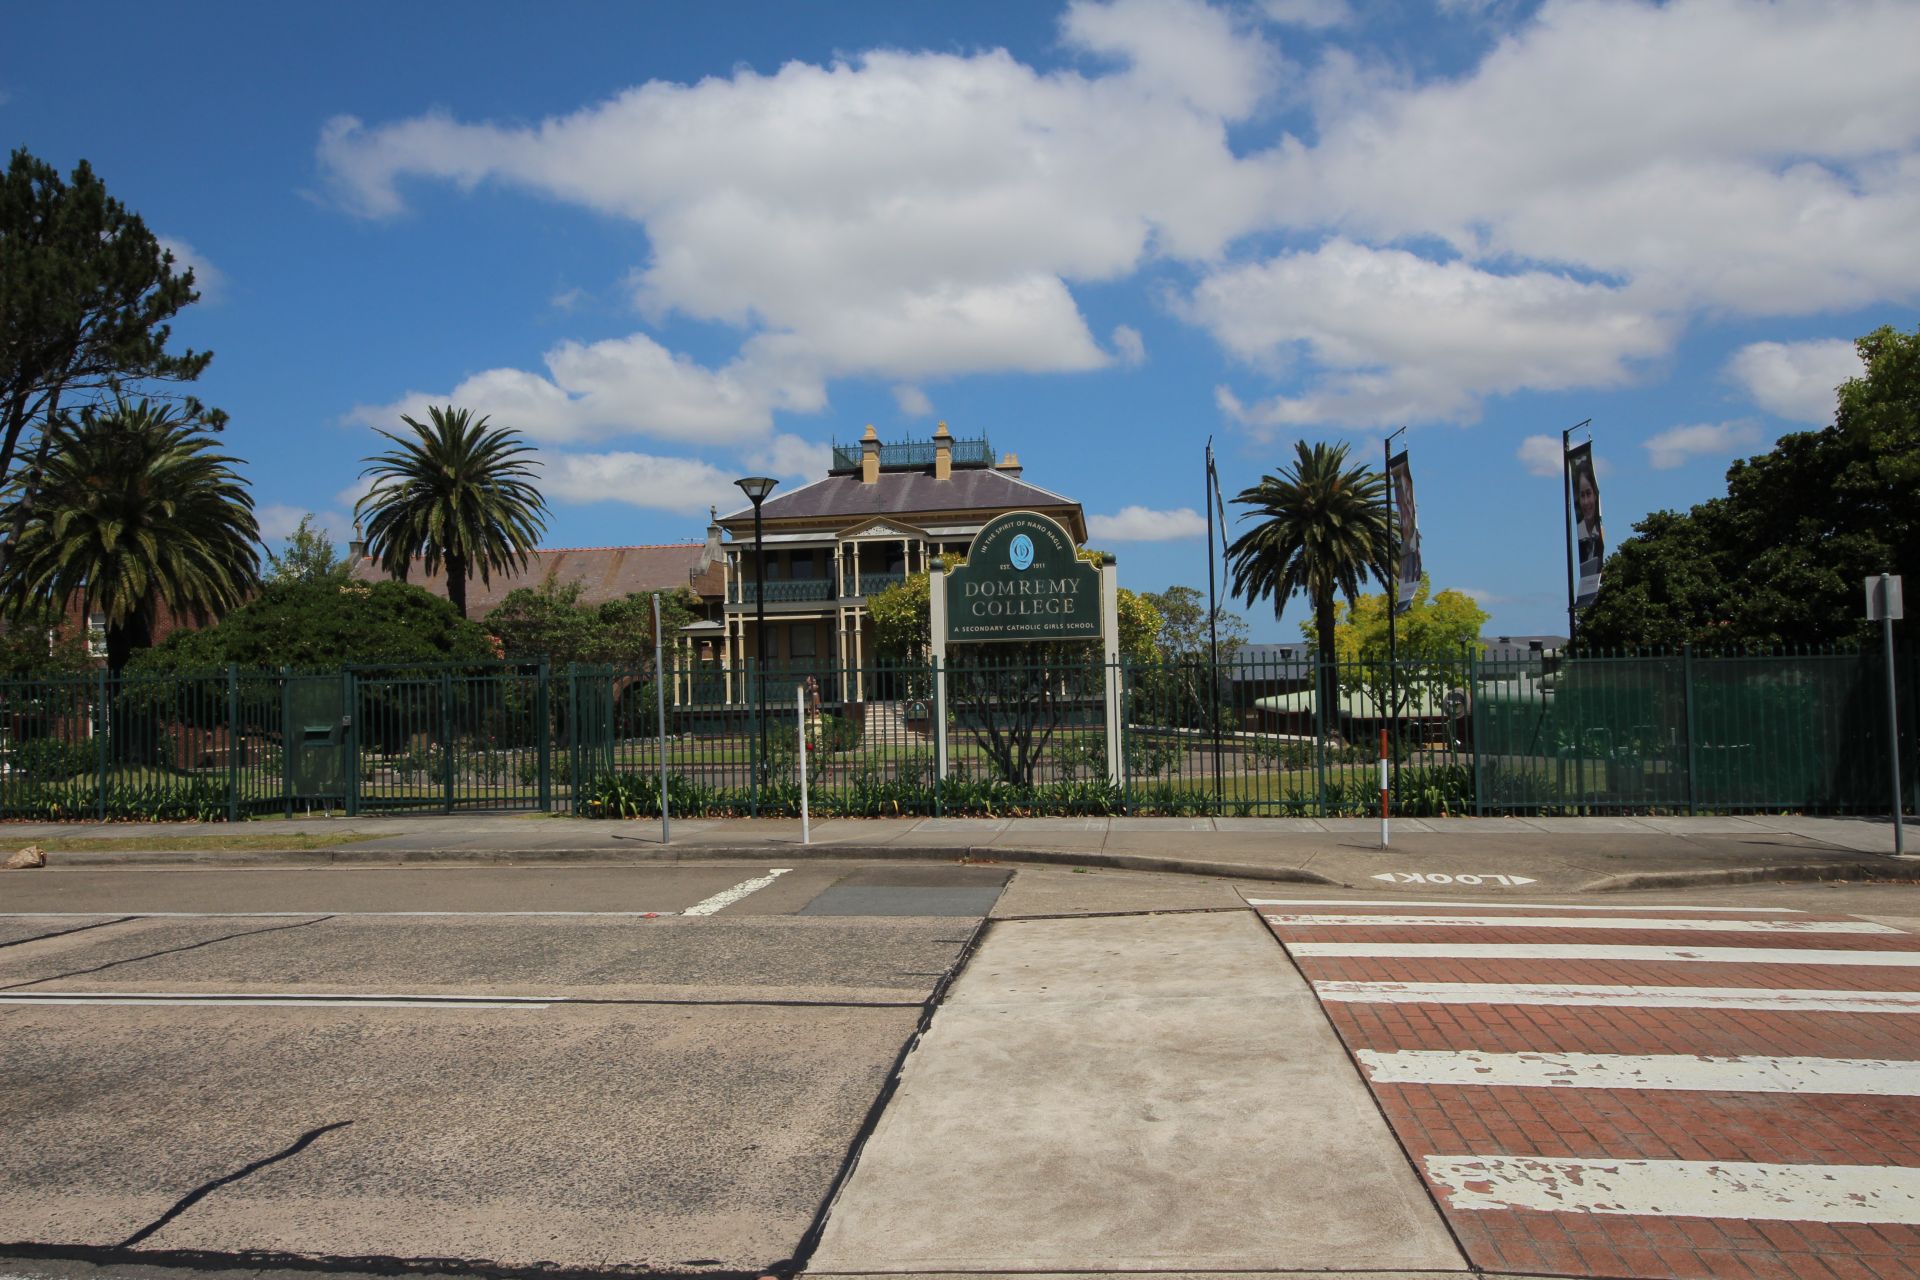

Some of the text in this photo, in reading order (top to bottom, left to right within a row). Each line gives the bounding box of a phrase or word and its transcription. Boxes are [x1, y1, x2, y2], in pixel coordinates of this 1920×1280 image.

[981, 545, 988, 553] IN
[985, 533, 996, 544] THE
[995, 522, 1014, 535] SPIRIT
[1027, 521, 1047, 532] NANO
[1046, 530, 1063, 551] NAGLE
[965, 578, 1081, 597] DOMREMY
[972, 598, 1075, 616] COLLEGE
[1395, 872, 1511, 886] LOOK
